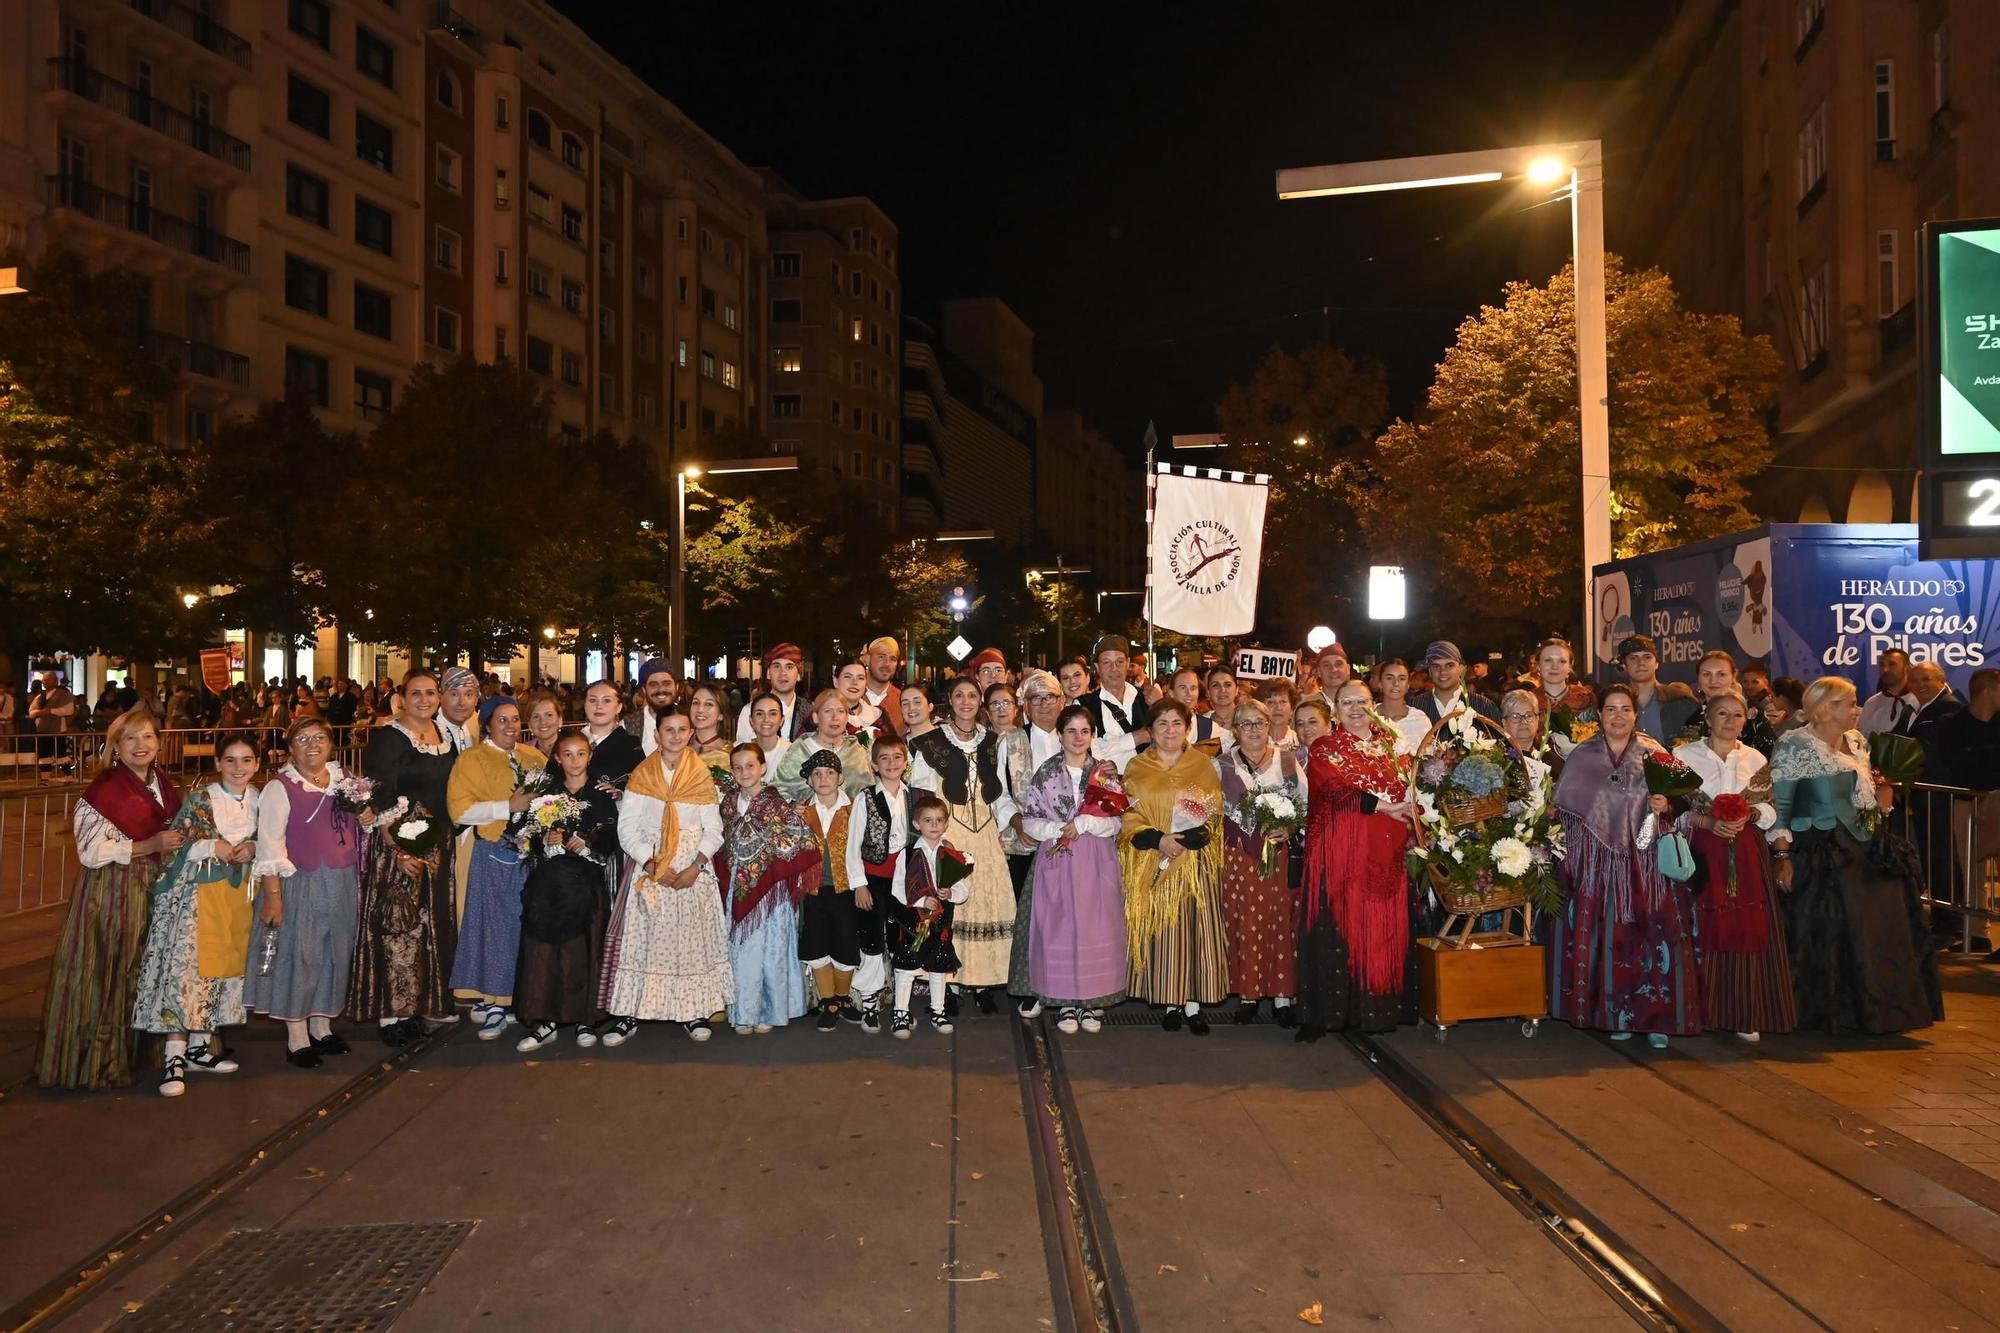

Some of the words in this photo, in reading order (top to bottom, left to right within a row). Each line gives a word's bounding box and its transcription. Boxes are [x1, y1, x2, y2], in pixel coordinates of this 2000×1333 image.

[1169, 525, 1194, 580] ASOCIACIÓN
[1195, 519, 1239, 547] CULTURAL
[1185, 583, 1212, 595] VILLA
[1215, 580, 1228, 592] DE
[1227, 555, 1241, 581] OBÓN
[1840, 579, 1940, 597] HERALDO
[1654, 583, 1687, 601] HERALDO
[1648, 610, 1671, 638] 130
[1674, 610, 1701, 636] años
[1830, 603, 1893, 634] 130
[1904, 607, 1978, 635] años
[1662, 636, 1705, 663] Pilares
[1822, 634, 1861, 666] de
[1240, 654, 1255, 673] EL
[1260, 656, 1294, 677] BAYO
